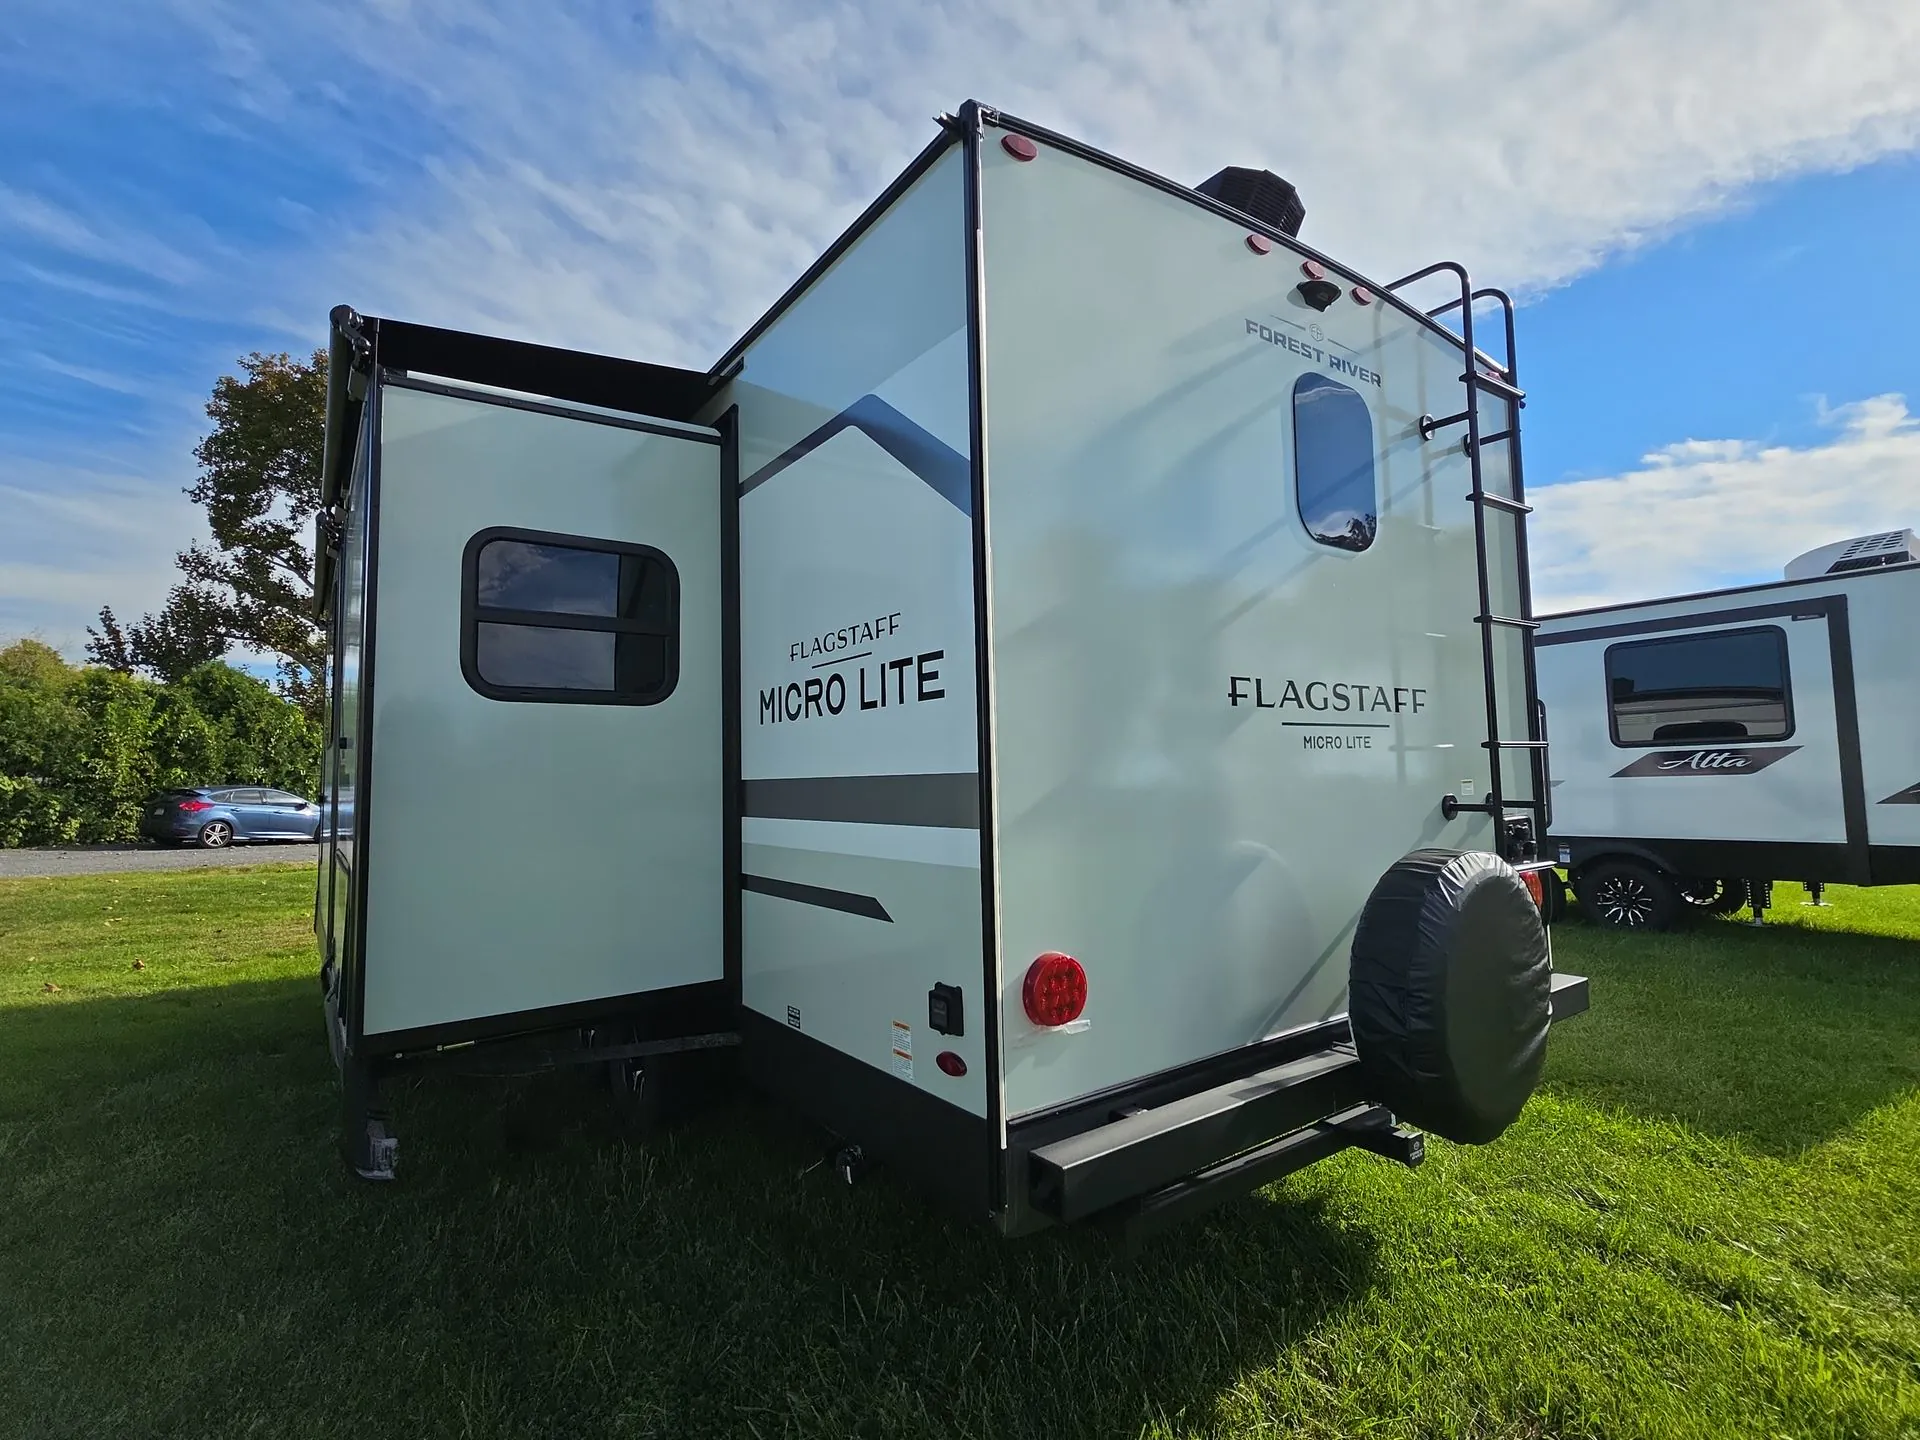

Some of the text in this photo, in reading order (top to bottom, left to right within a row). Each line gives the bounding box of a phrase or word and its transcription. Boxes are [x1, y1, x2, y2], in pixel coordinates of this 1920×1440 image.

[1245, 318, 1325, 363] FOREST
[1329, 354, 1382, 388] RIVER
[789, 612, 902, 662] FLAGSTAFF
[760, 650, 945, 725] MICRO LITE
[1228, 676, 1427, 714] FLAGSTAFF
[1303, 735, 1372, 750] MICRO LITE
[1657, 751, 1753, 770] Alta
